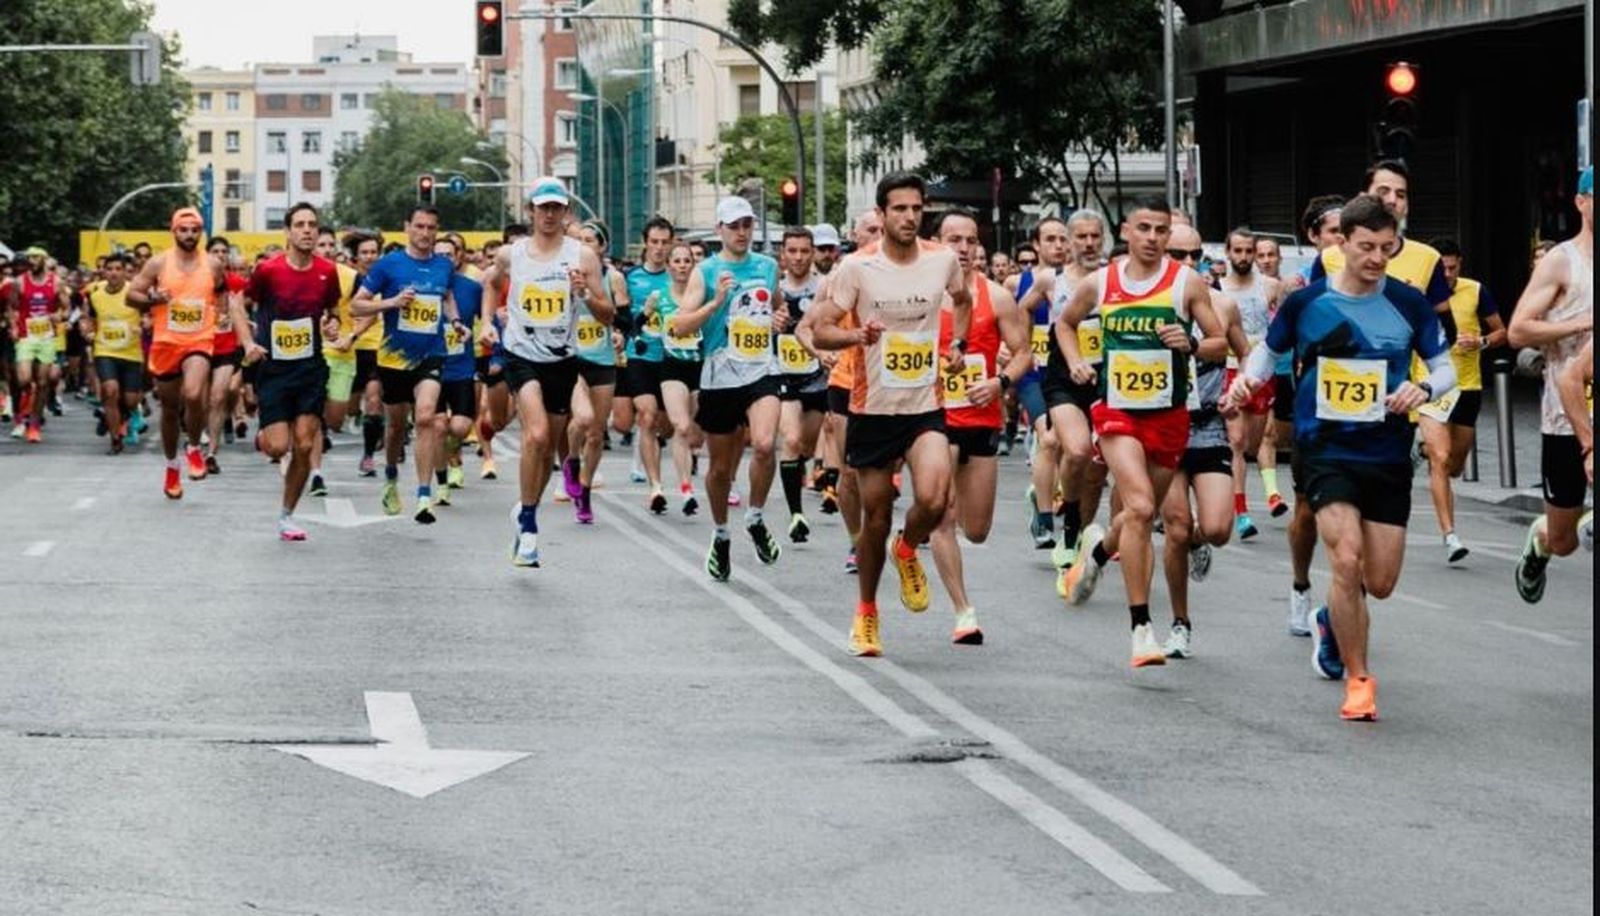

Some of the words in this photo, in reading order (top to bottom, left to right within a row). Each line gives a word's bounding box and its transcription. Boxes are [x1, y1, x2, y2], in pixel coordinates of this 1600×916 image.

[522, 298, 564, 313] 4111
[275, 333, 311, 348] 4033
[734, 333, 770, 348] 1883
[885, 351, 934, 371] 3304
[1113, 372, 1168, 391] 1293
[1323, 380, 1378, 403] 1731
